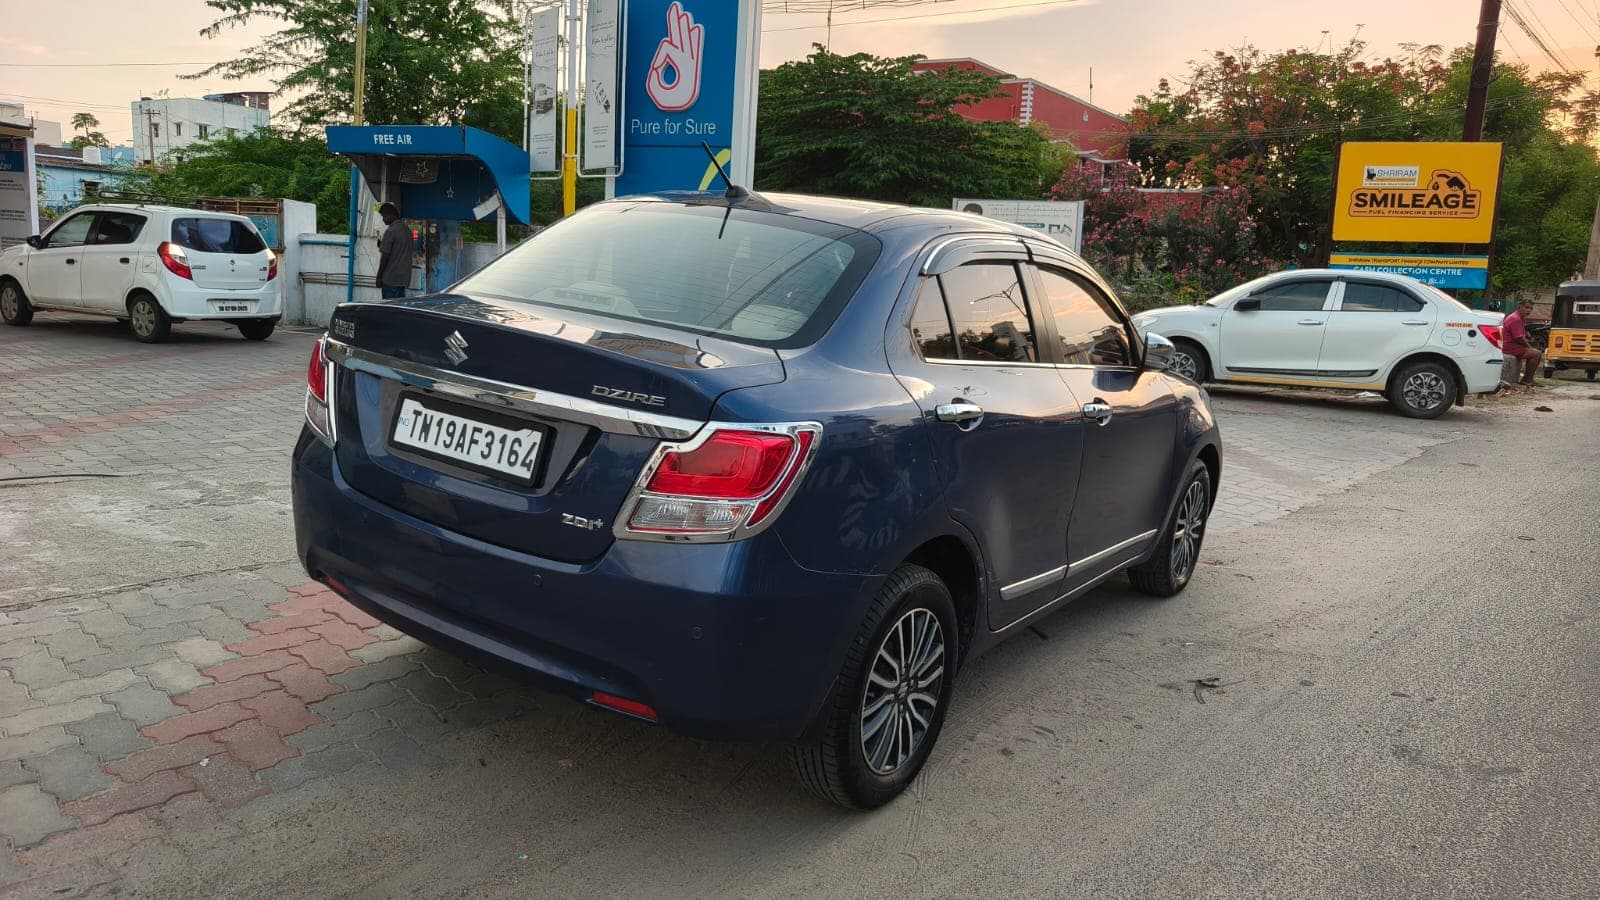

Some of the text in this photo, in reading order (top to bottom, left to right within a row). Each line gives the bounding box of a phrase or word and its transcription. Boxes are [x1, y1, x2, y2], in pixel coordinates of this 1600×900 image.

[631, 118, 717, 135] Pure for Sure
[373, 134, 413, 145] FREE AIR
[1376, 169, 1417, 178] SHRIRAM
[1354, 192, 1477, 209] SMILEAGE
[1377, 266, 1428, 275] COLLECTION
[1429, 268, 1463, 276] CENTRE
[591, 385, 667, 407] DZIRE
[409, 409, 538, 472] TN19AF3164
